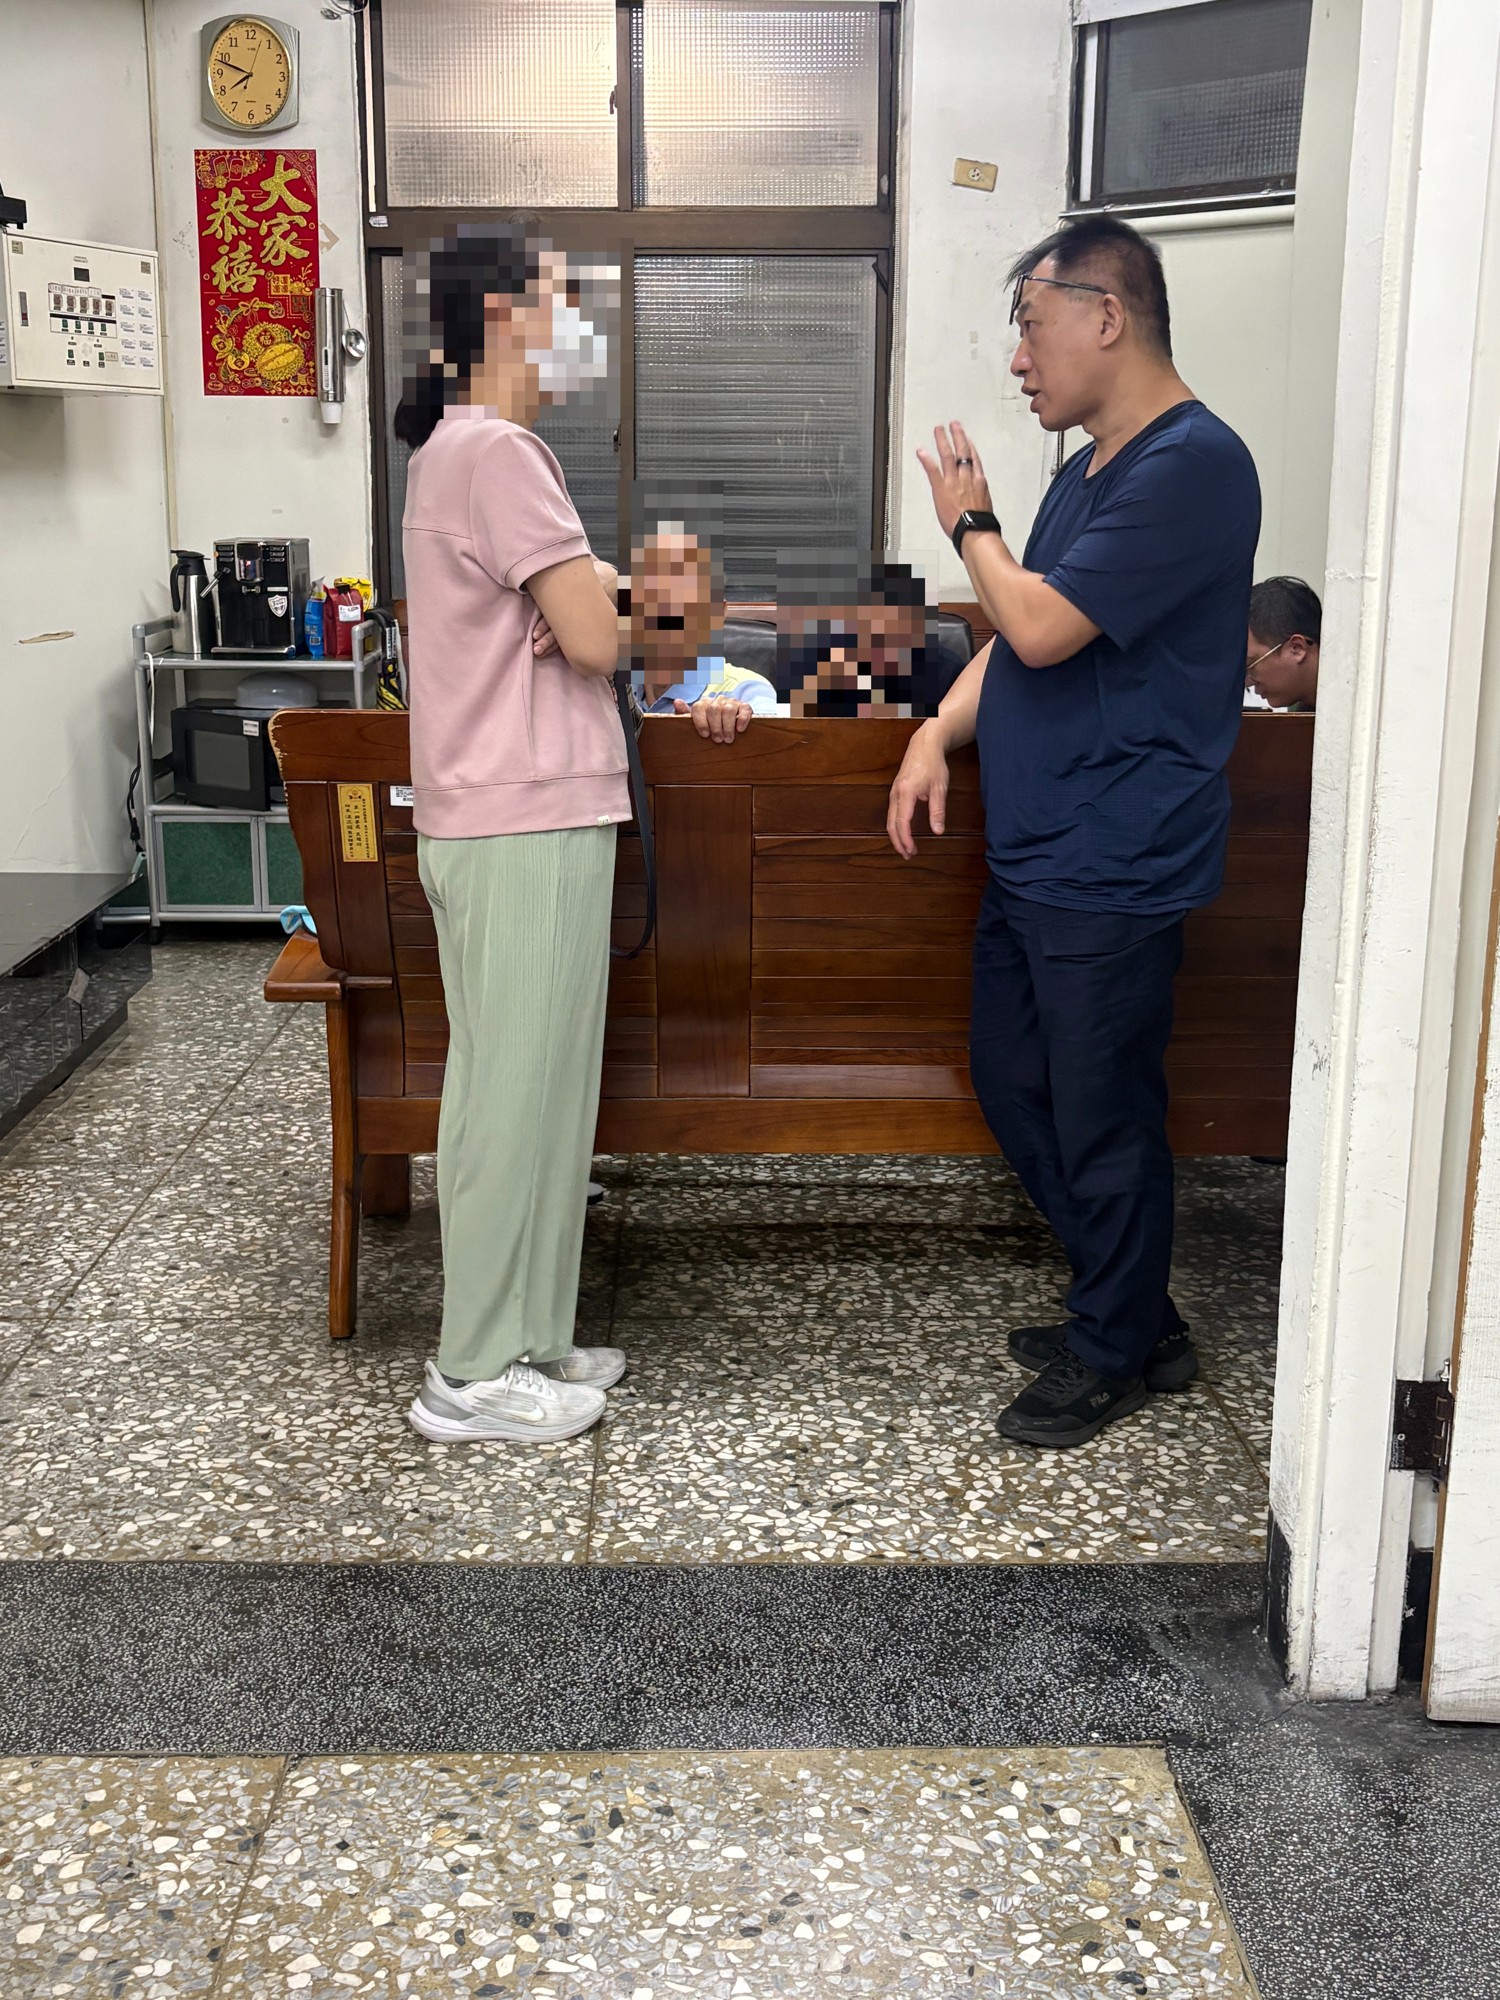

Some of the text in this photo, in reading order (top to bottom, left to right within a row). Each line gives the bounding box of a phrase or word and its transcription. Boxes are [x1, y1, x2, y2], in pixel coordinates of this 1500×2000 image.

[245, 29, 257, 40] 12
[228, 37, 239, 48] 11
[266, 39, 272, 49] 1
[219, 52, 231, 63] 10
[275, 53, 282, 64] 2
[216, 68, 224, 79] 9
[279, 71, 286, 82] 3
[219, 85, 227, 96] 8
[275, 88, 282, 98] 4
[231, 101, 238, 112] 7
[265, 104, 272, 115] 5
[247, 109, 255, 120] 6
[252, 154, 312, 266] 大家
[202, 186, 265, 294] 恭禧
[1089, 1391, 1110, 1408] FILA
